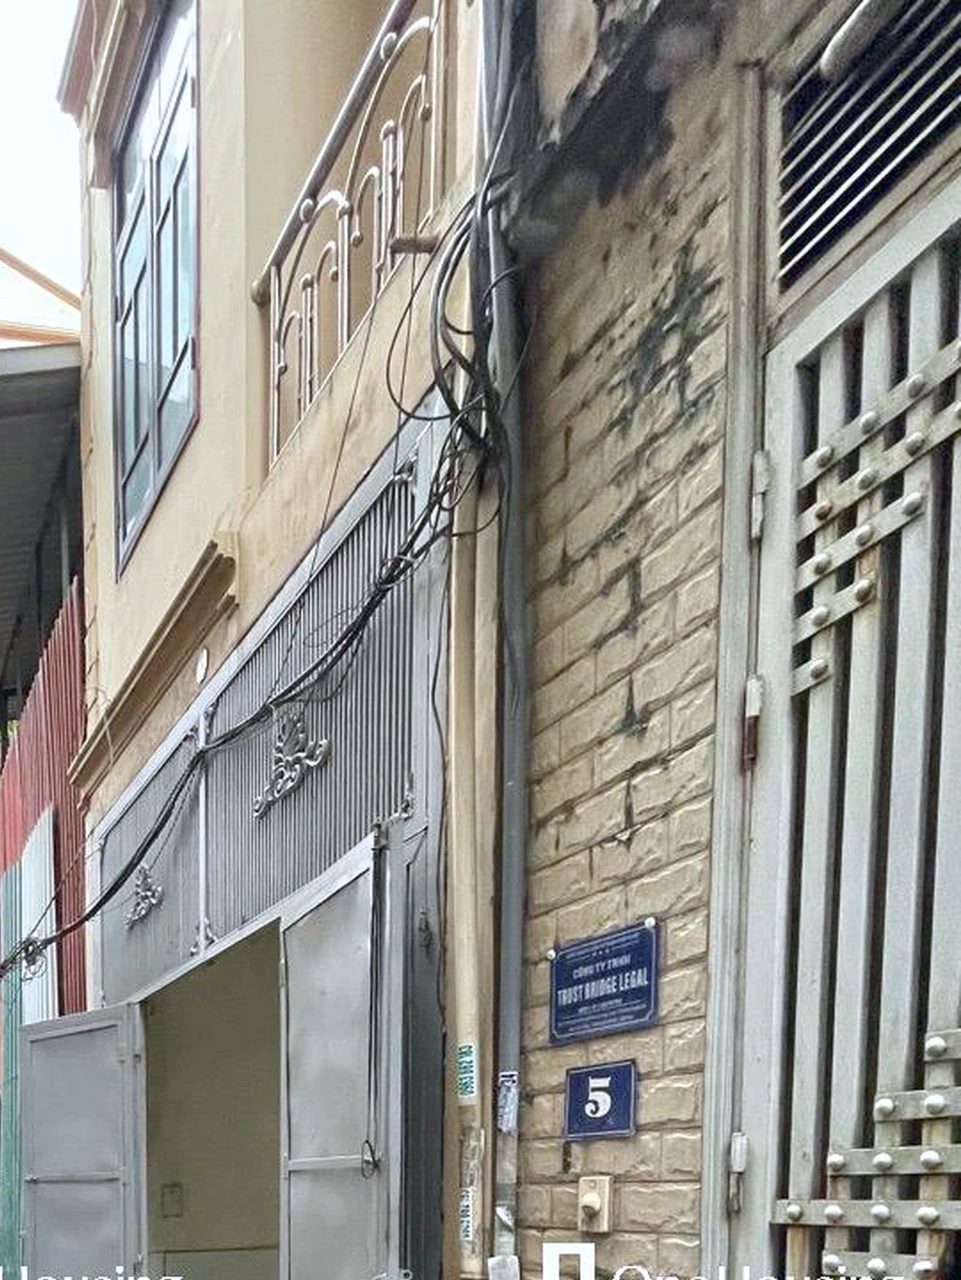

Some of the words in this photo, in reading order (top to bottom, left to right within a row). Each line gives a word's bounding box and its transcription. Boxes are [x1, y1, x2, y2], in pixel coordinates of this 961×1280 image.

[557, 984, 583, 1006] TRUST
[584, 976, 617, 1000] BRIDGE
[619, 967, 649, 991] LEGAL
[584, 1075, 612, 1118] 5
